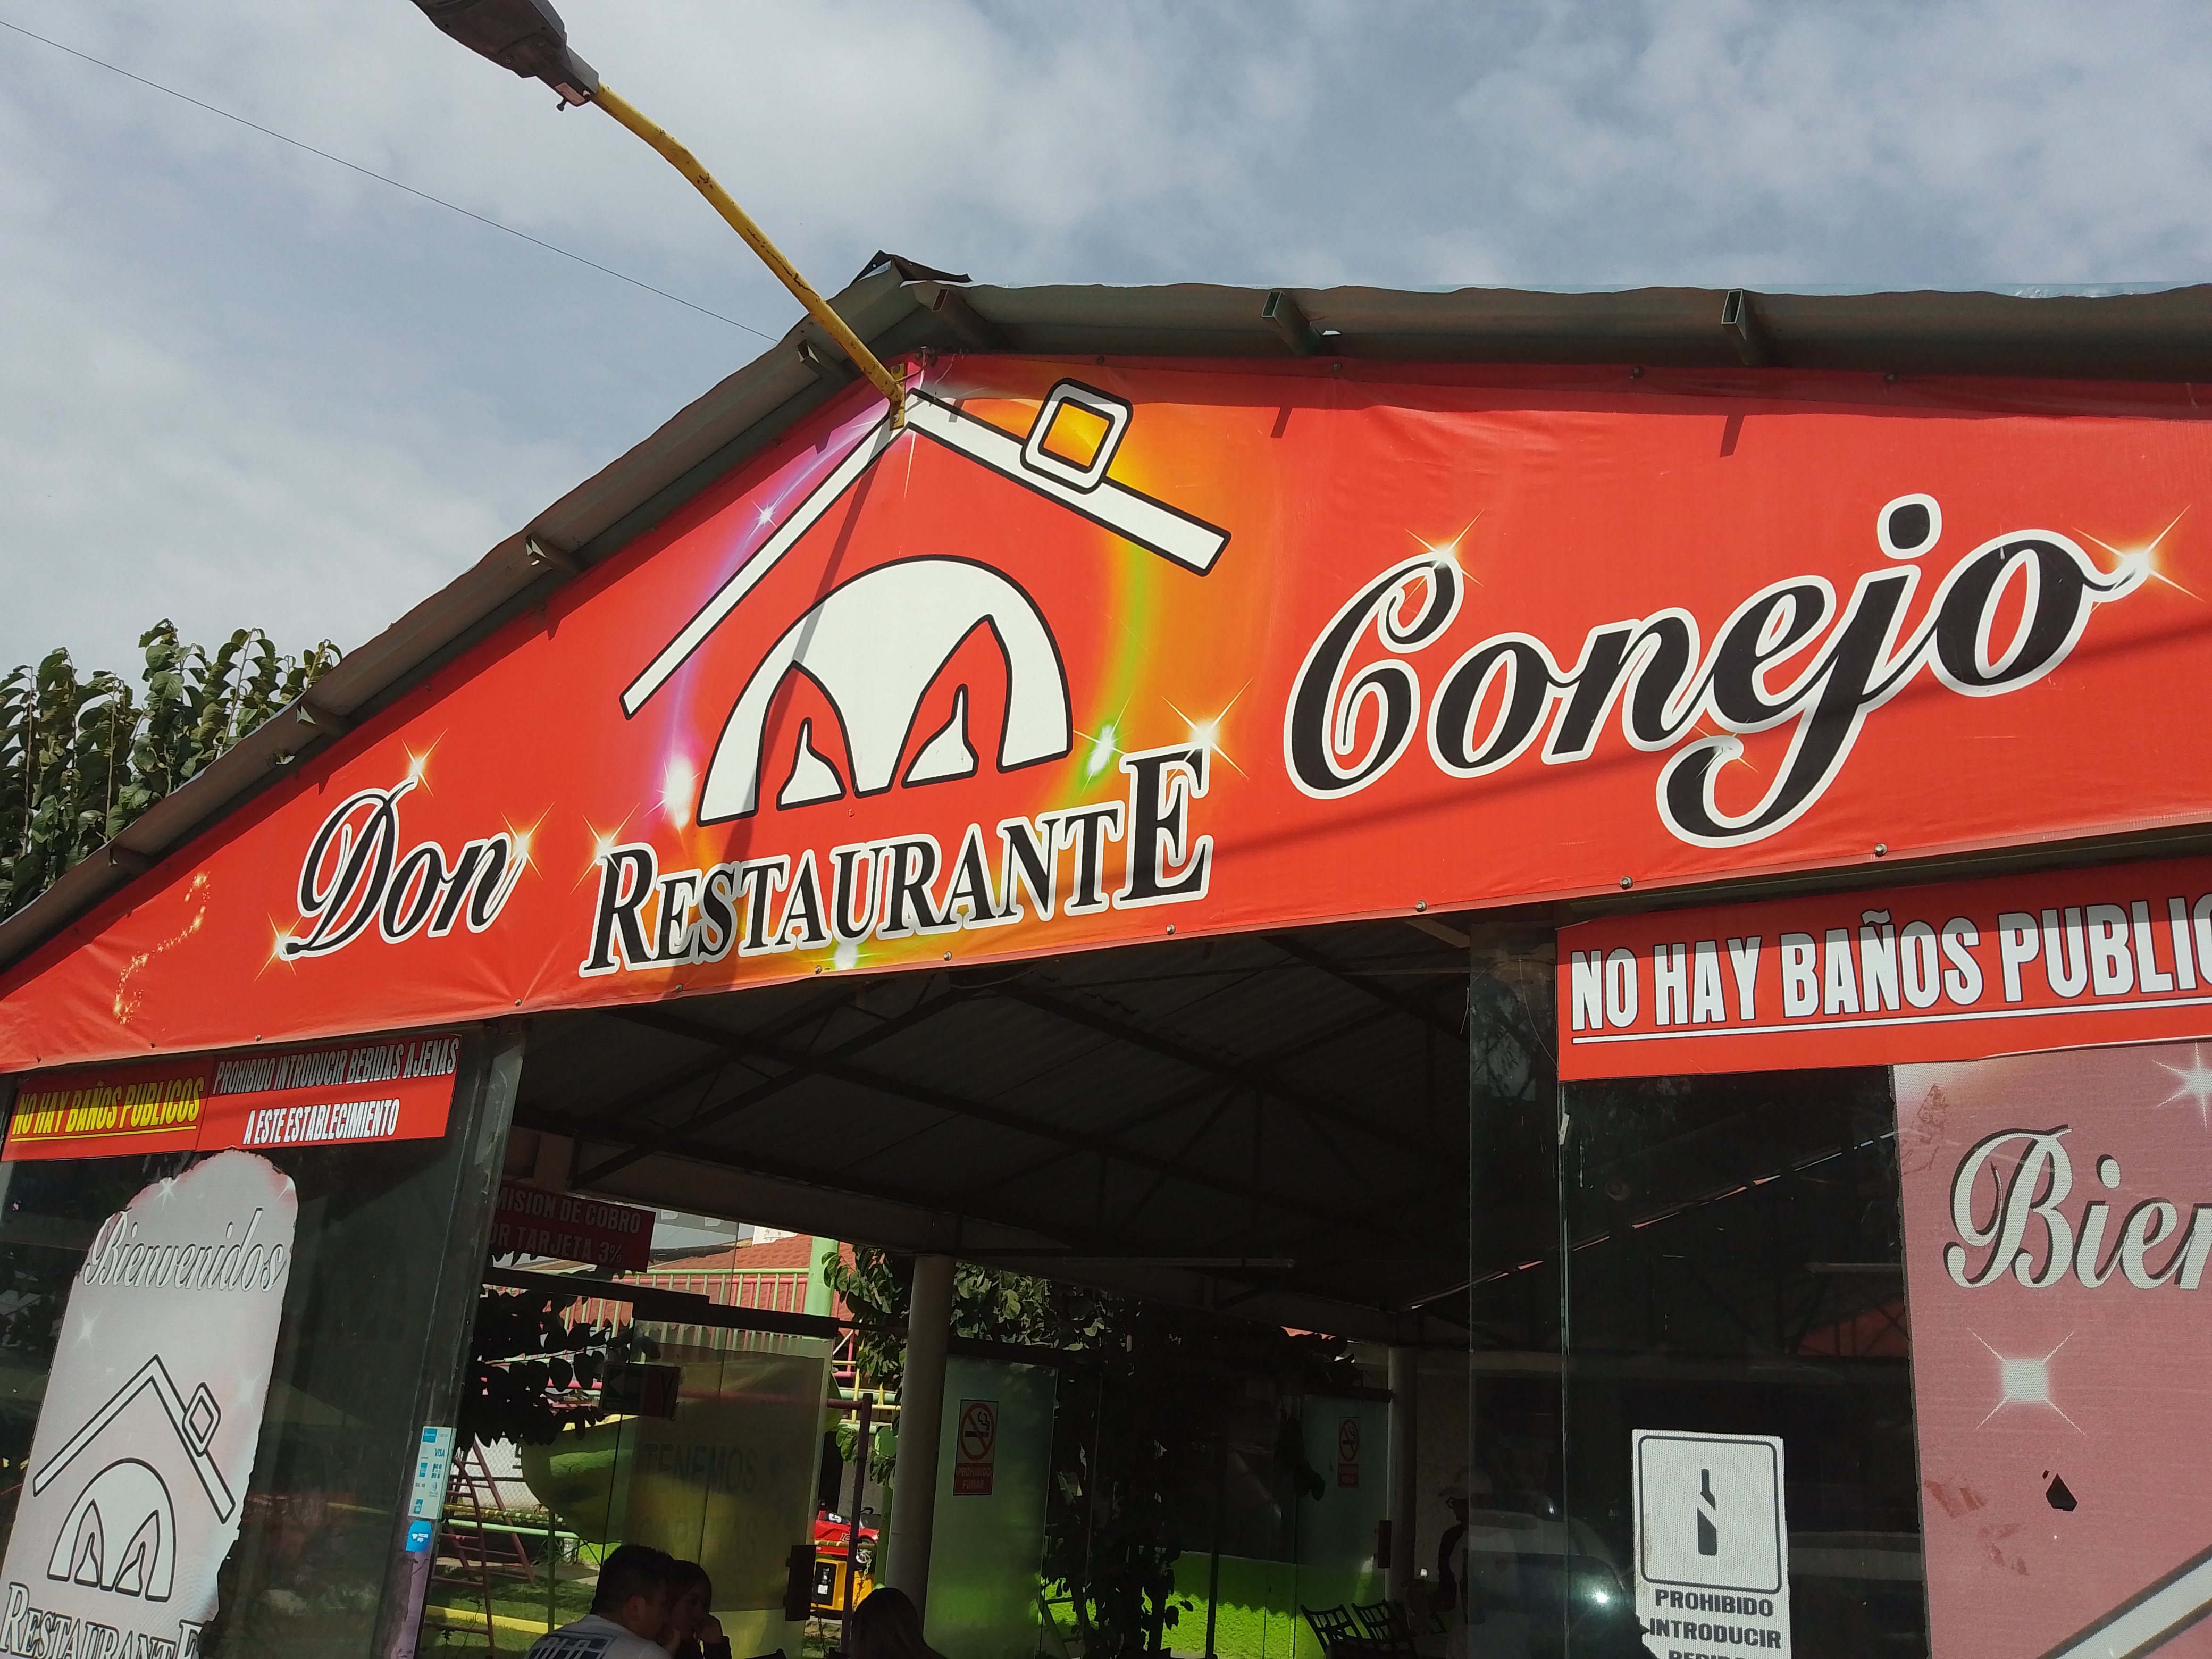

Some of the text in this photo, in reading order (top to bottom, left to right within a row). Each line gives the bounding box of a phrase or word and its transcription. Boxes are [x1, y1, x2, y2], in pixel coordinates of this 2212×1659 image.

[1283, 493, 2149, 848] Conejo
[279, 776, 528, 960] Don
[578, 742, 1213, 978] RESTAURANTE
[1570, 947, 1638, 1030] NO
[1654, 935, 1762, 1026] HAY
[1780, 909, 1984, 1017] BAÑOS
[212, 1037, 460, 1094] PROHIBIDO INTRODUCIR BEBIDAS AJENAS
[12, 1076, 204, 1135] NO HAY BAÑOS PUBLICOS
[242, 1099, 400, 1145] A ESTE ESTABLECIMIENTO
[516, 1225, 593, 1261] TARJETA
[598, 1241, 623, 1264] 3%
[559, 1198, 583, 1224] DE
[585, 1203, 641, 1235] COBRO
[83, 1207, 287, 1293] Bienvenidos
[1655, 1589, 1773, 1617] PROHIBIDO
[1650, 1618, 1782, 1649] INTRODUCIR
